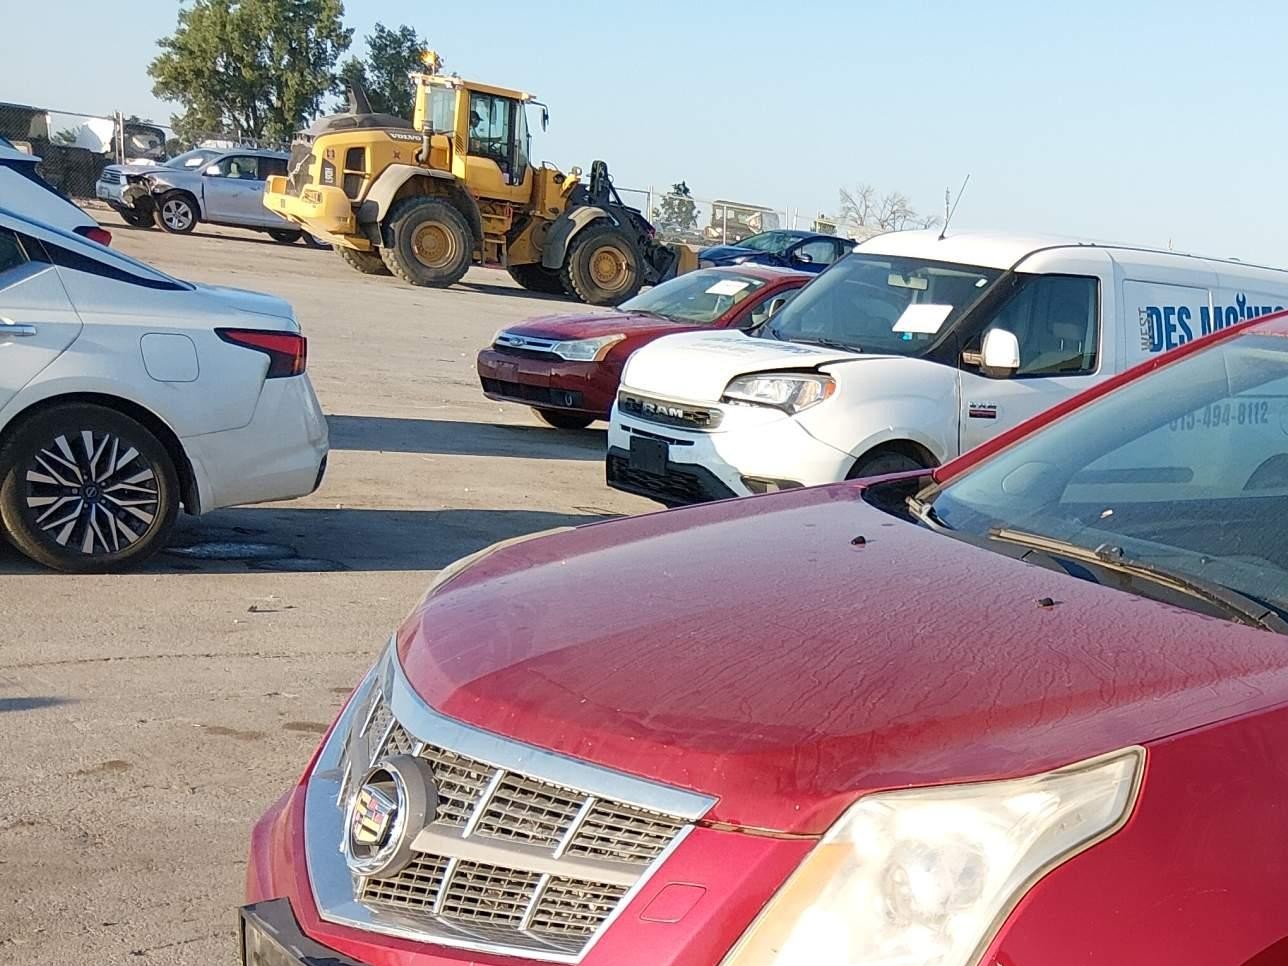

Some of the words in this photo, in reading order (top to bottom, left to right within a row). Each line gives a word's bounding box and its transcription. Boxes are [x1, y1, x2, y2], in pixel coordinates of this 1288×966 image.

[390, 132, 422, 141] VOLVO
[1138, 306, 1154, 352] WEST
[1147, 305, 1193, 353] DES
[642, 402, 684, 418] RAM
